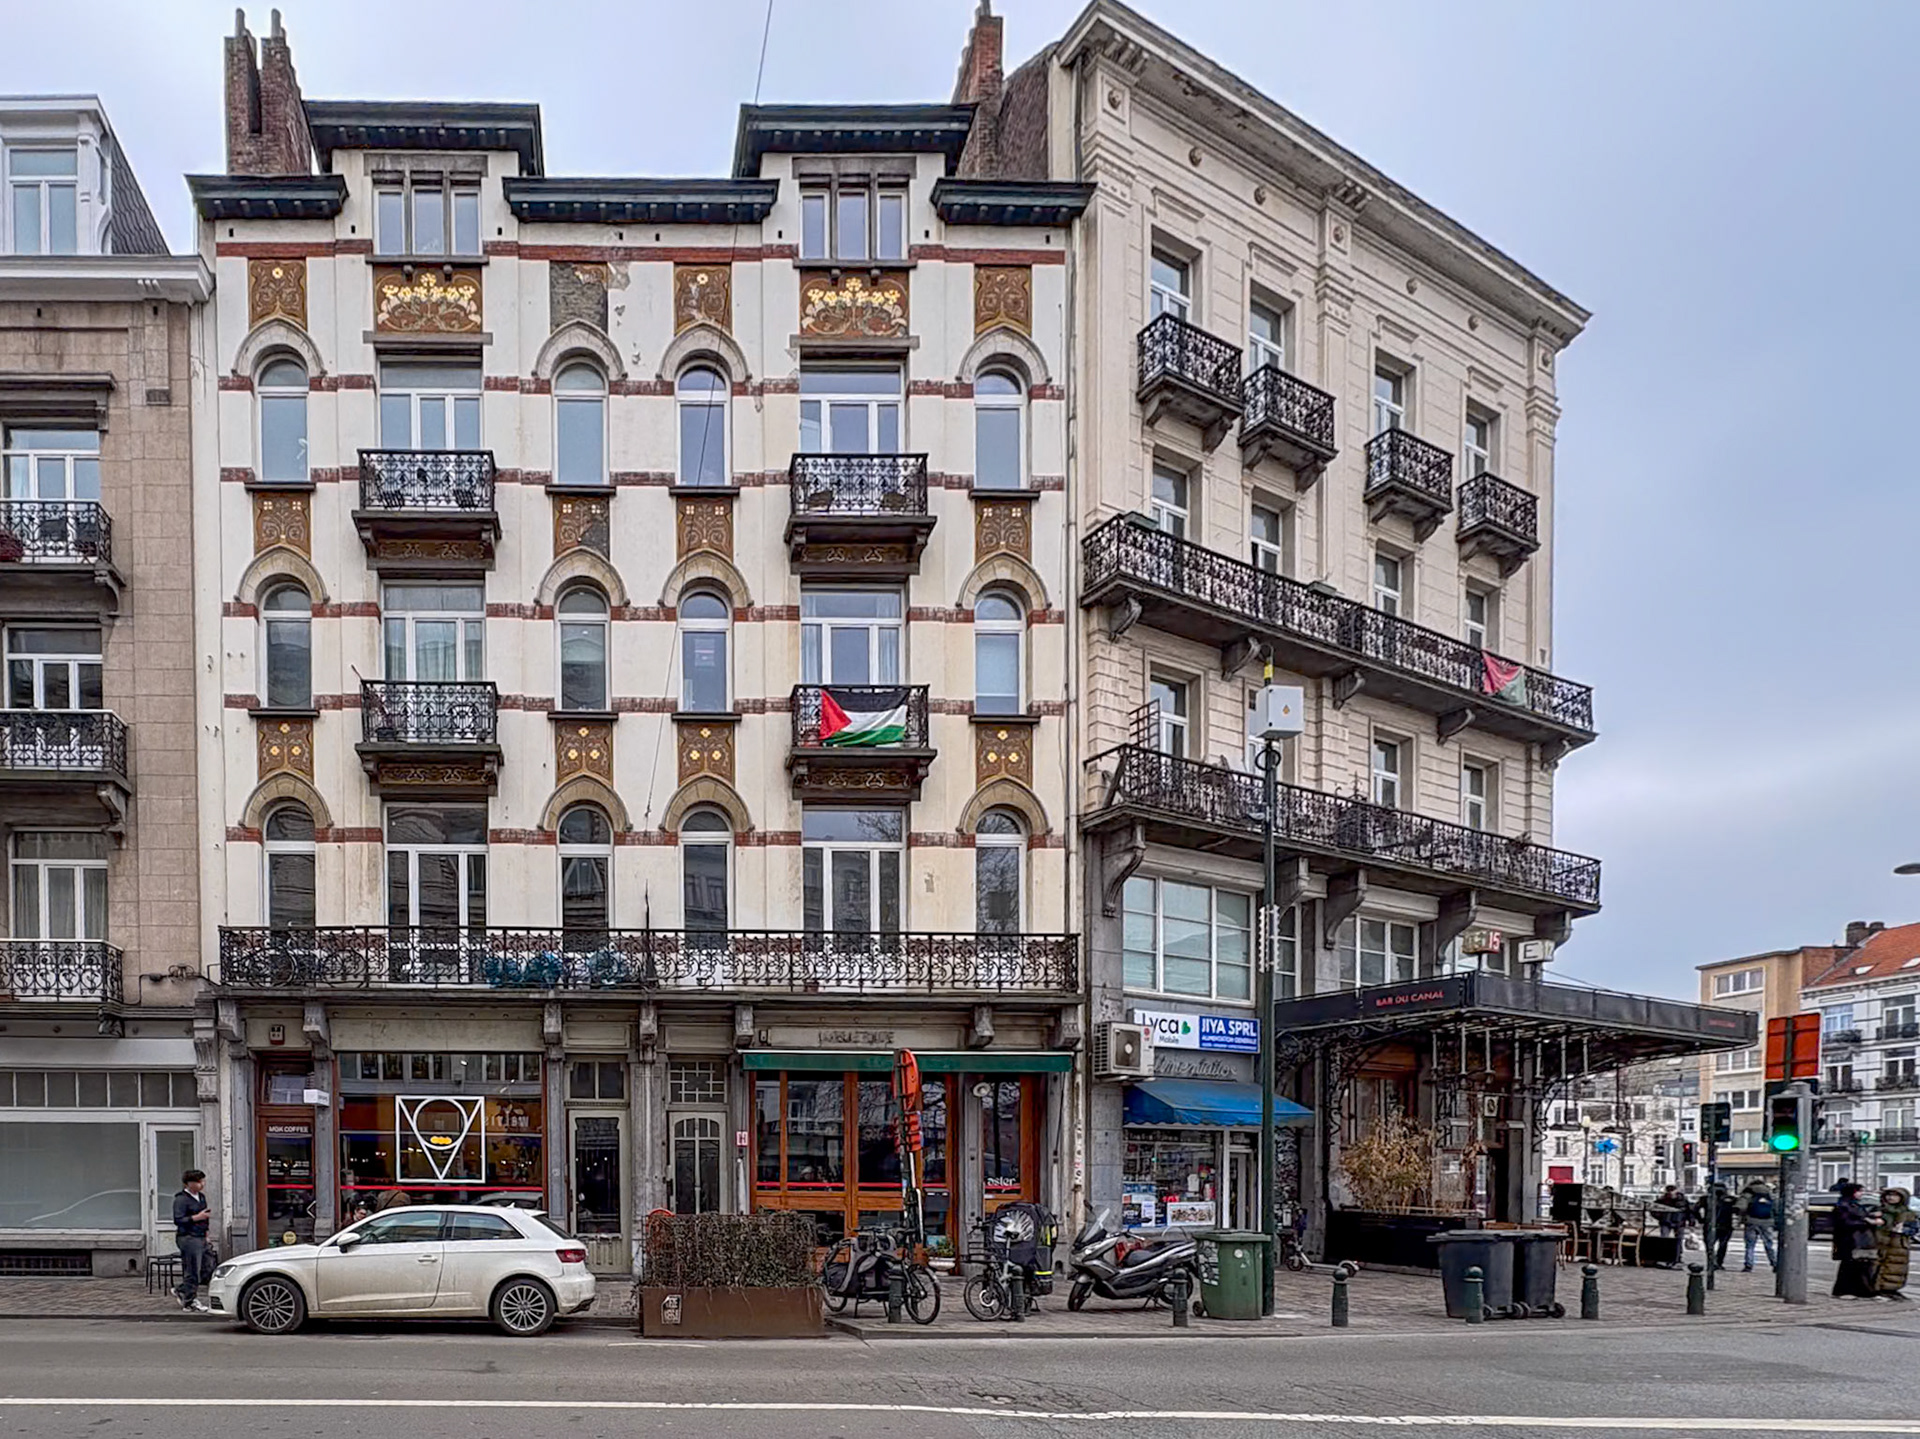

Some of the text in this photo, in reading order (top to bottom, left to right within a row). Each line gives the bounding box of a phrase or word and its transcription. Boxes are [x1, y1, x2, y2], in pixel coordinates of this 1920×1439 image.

[1376, 991, 1444, 1007] BAR DU CANAL
[1201, 1018, 1257, 1037] JIYA SPRL
[1159, 1035, 1179, 1044] Mobile
[284, 1125, 309, 1133] COFFEE
